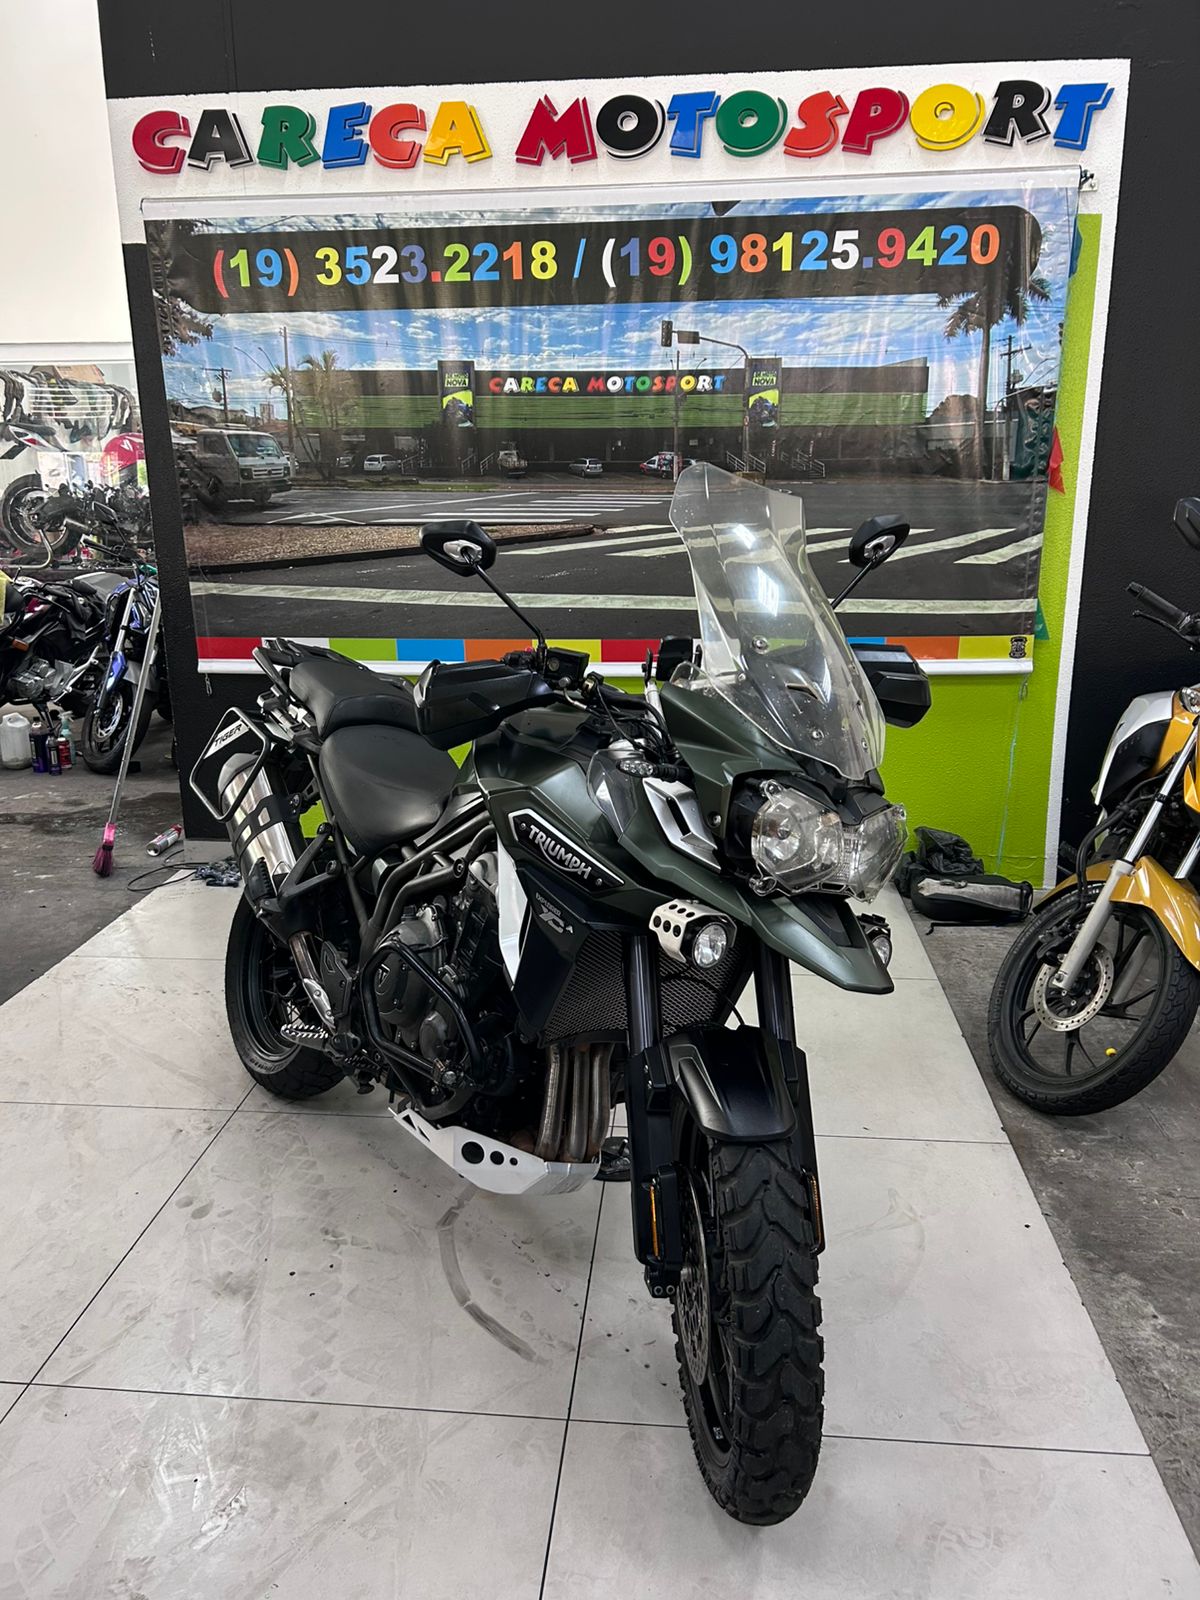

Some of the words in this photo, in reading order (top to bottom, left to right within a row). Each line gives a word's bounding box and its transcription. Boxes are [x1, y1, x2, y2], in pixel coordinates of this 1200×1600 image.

[132, 100, 494, 174] CARECA
[515, 79, 1115, 166] MOTOSPORT
[213, 247, 299, 298] (19)
[315, 239, 558, 286] 3523.2218
[601, 236, 692, 288] (19)
[710, 223, 1000, 275] 98125.9420
[445, 379, 468, 387] NOVA
[489, 376, 580, 393] CARECA
[586, 374, 726, 393] MOTOSPORT
[753, 377, 775, 386] NOVA
[214, 724, 243, 747] TIGER
[529, 824, 592, 879] TRIUMPH
